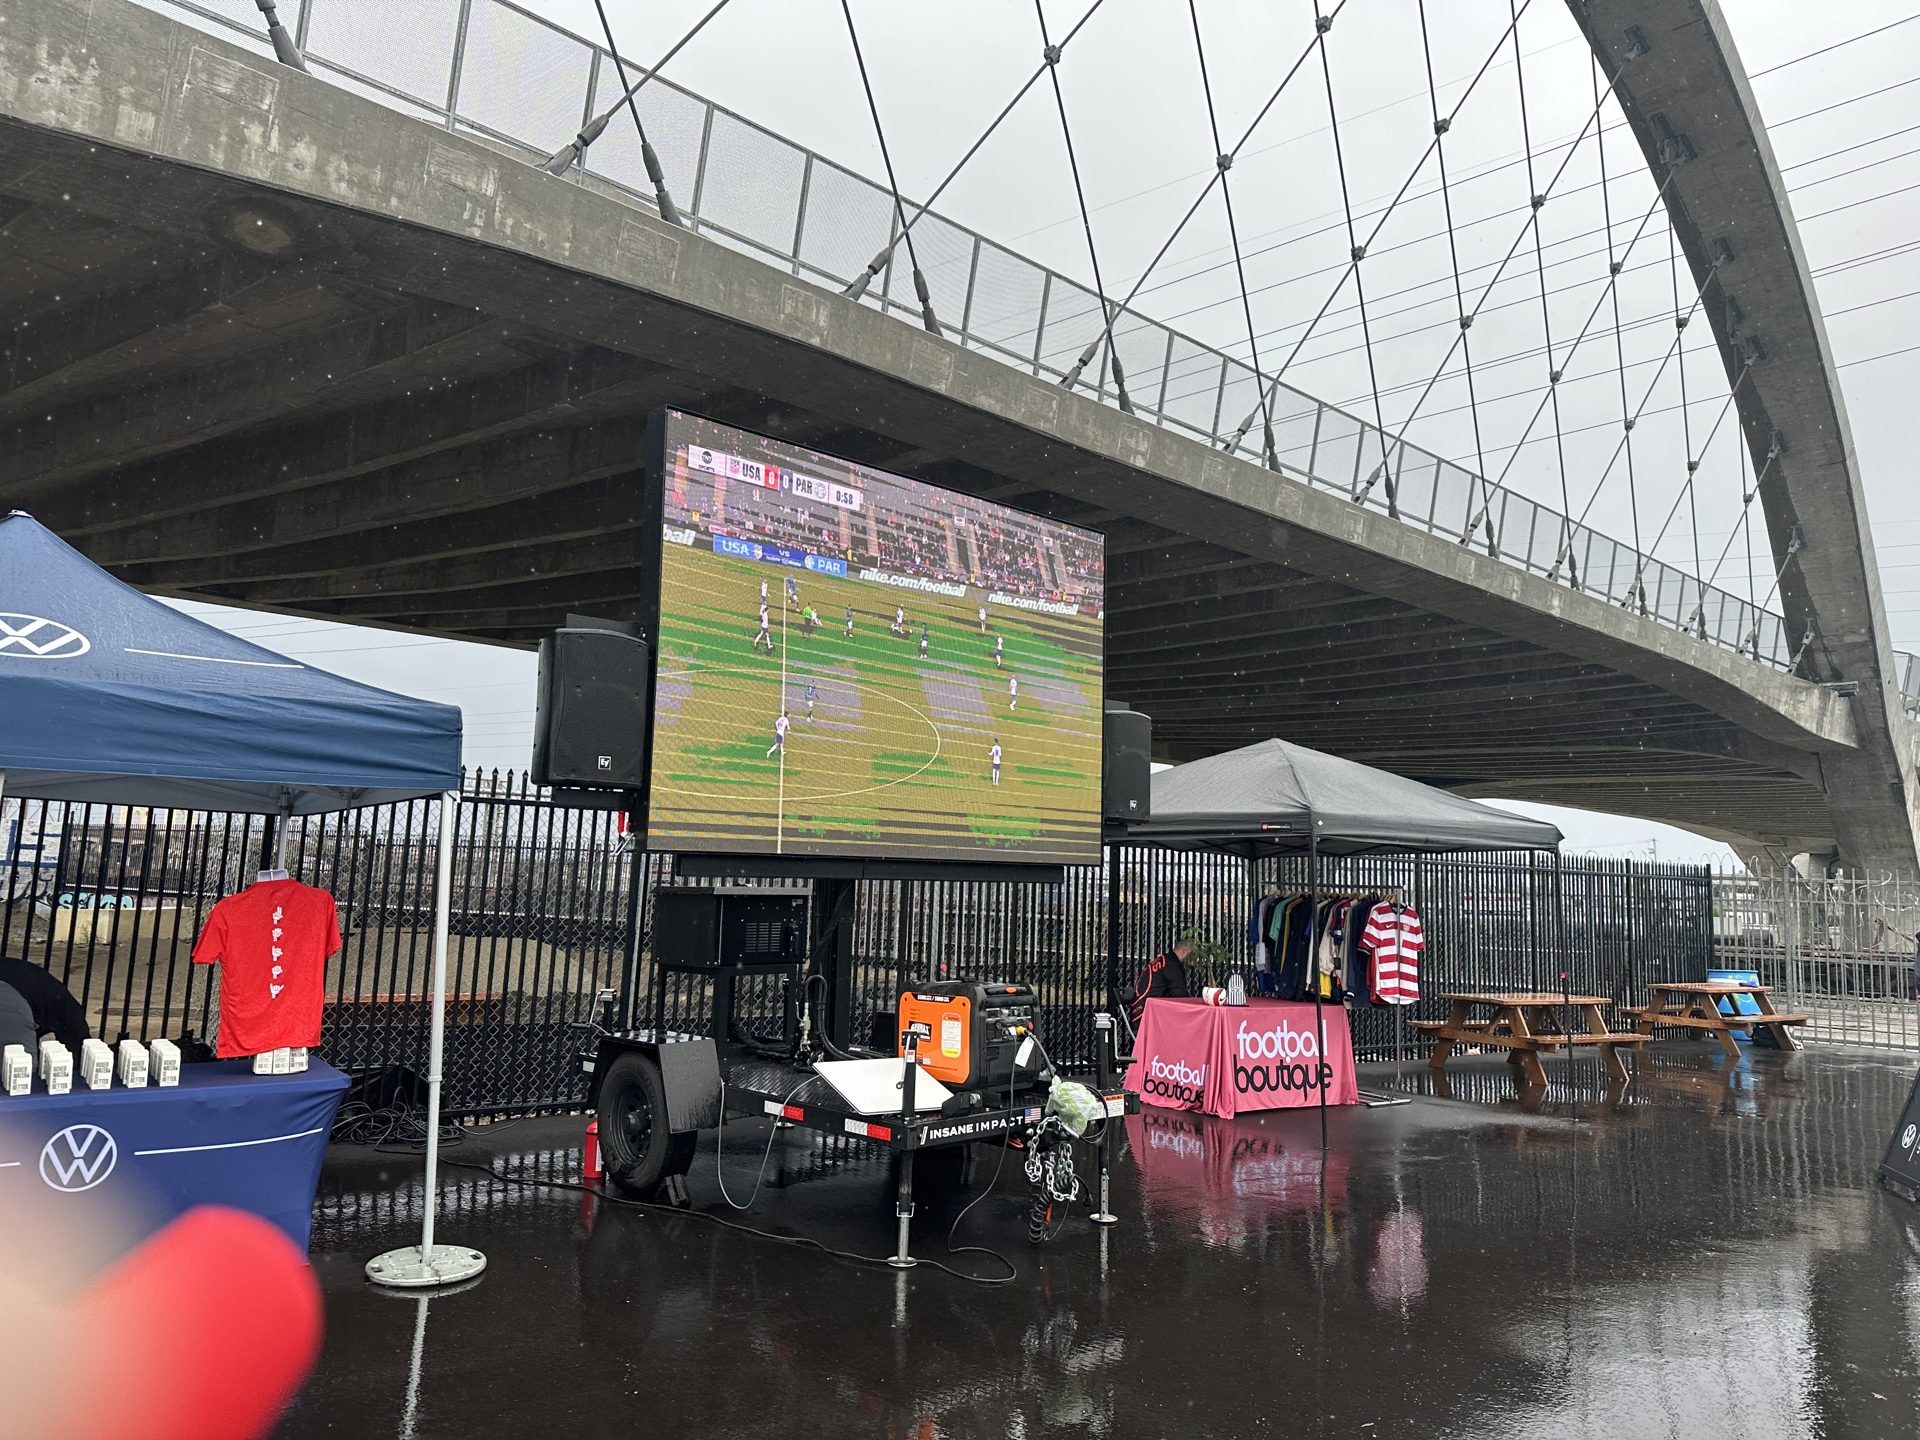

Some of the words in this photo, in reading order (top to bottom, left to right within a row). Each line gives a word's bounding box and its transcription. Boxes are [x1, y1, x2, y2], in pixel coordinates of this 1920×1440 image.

[742, 463, 761, 481] USA
[768, 473, 775, 485] 0
[783, 475, 789, 489] 0
[796, 478, 813, 495] PAR
[836, 490, 853, 505] 0:58
[722, 540, 750, 556] USA
[817, 559, 841, 574] PAR
[859, 568, 967, 598] nike.com/football
[987, 591, 1079, 616] nike.com/football
[1237, 1020, 1328, 1060] footbal
[1233, 1054, 1333, 1102] boutique
[930, 1124, 974, 1140] INSANE
[976, 1116, 1023, 1132] IMPACT
